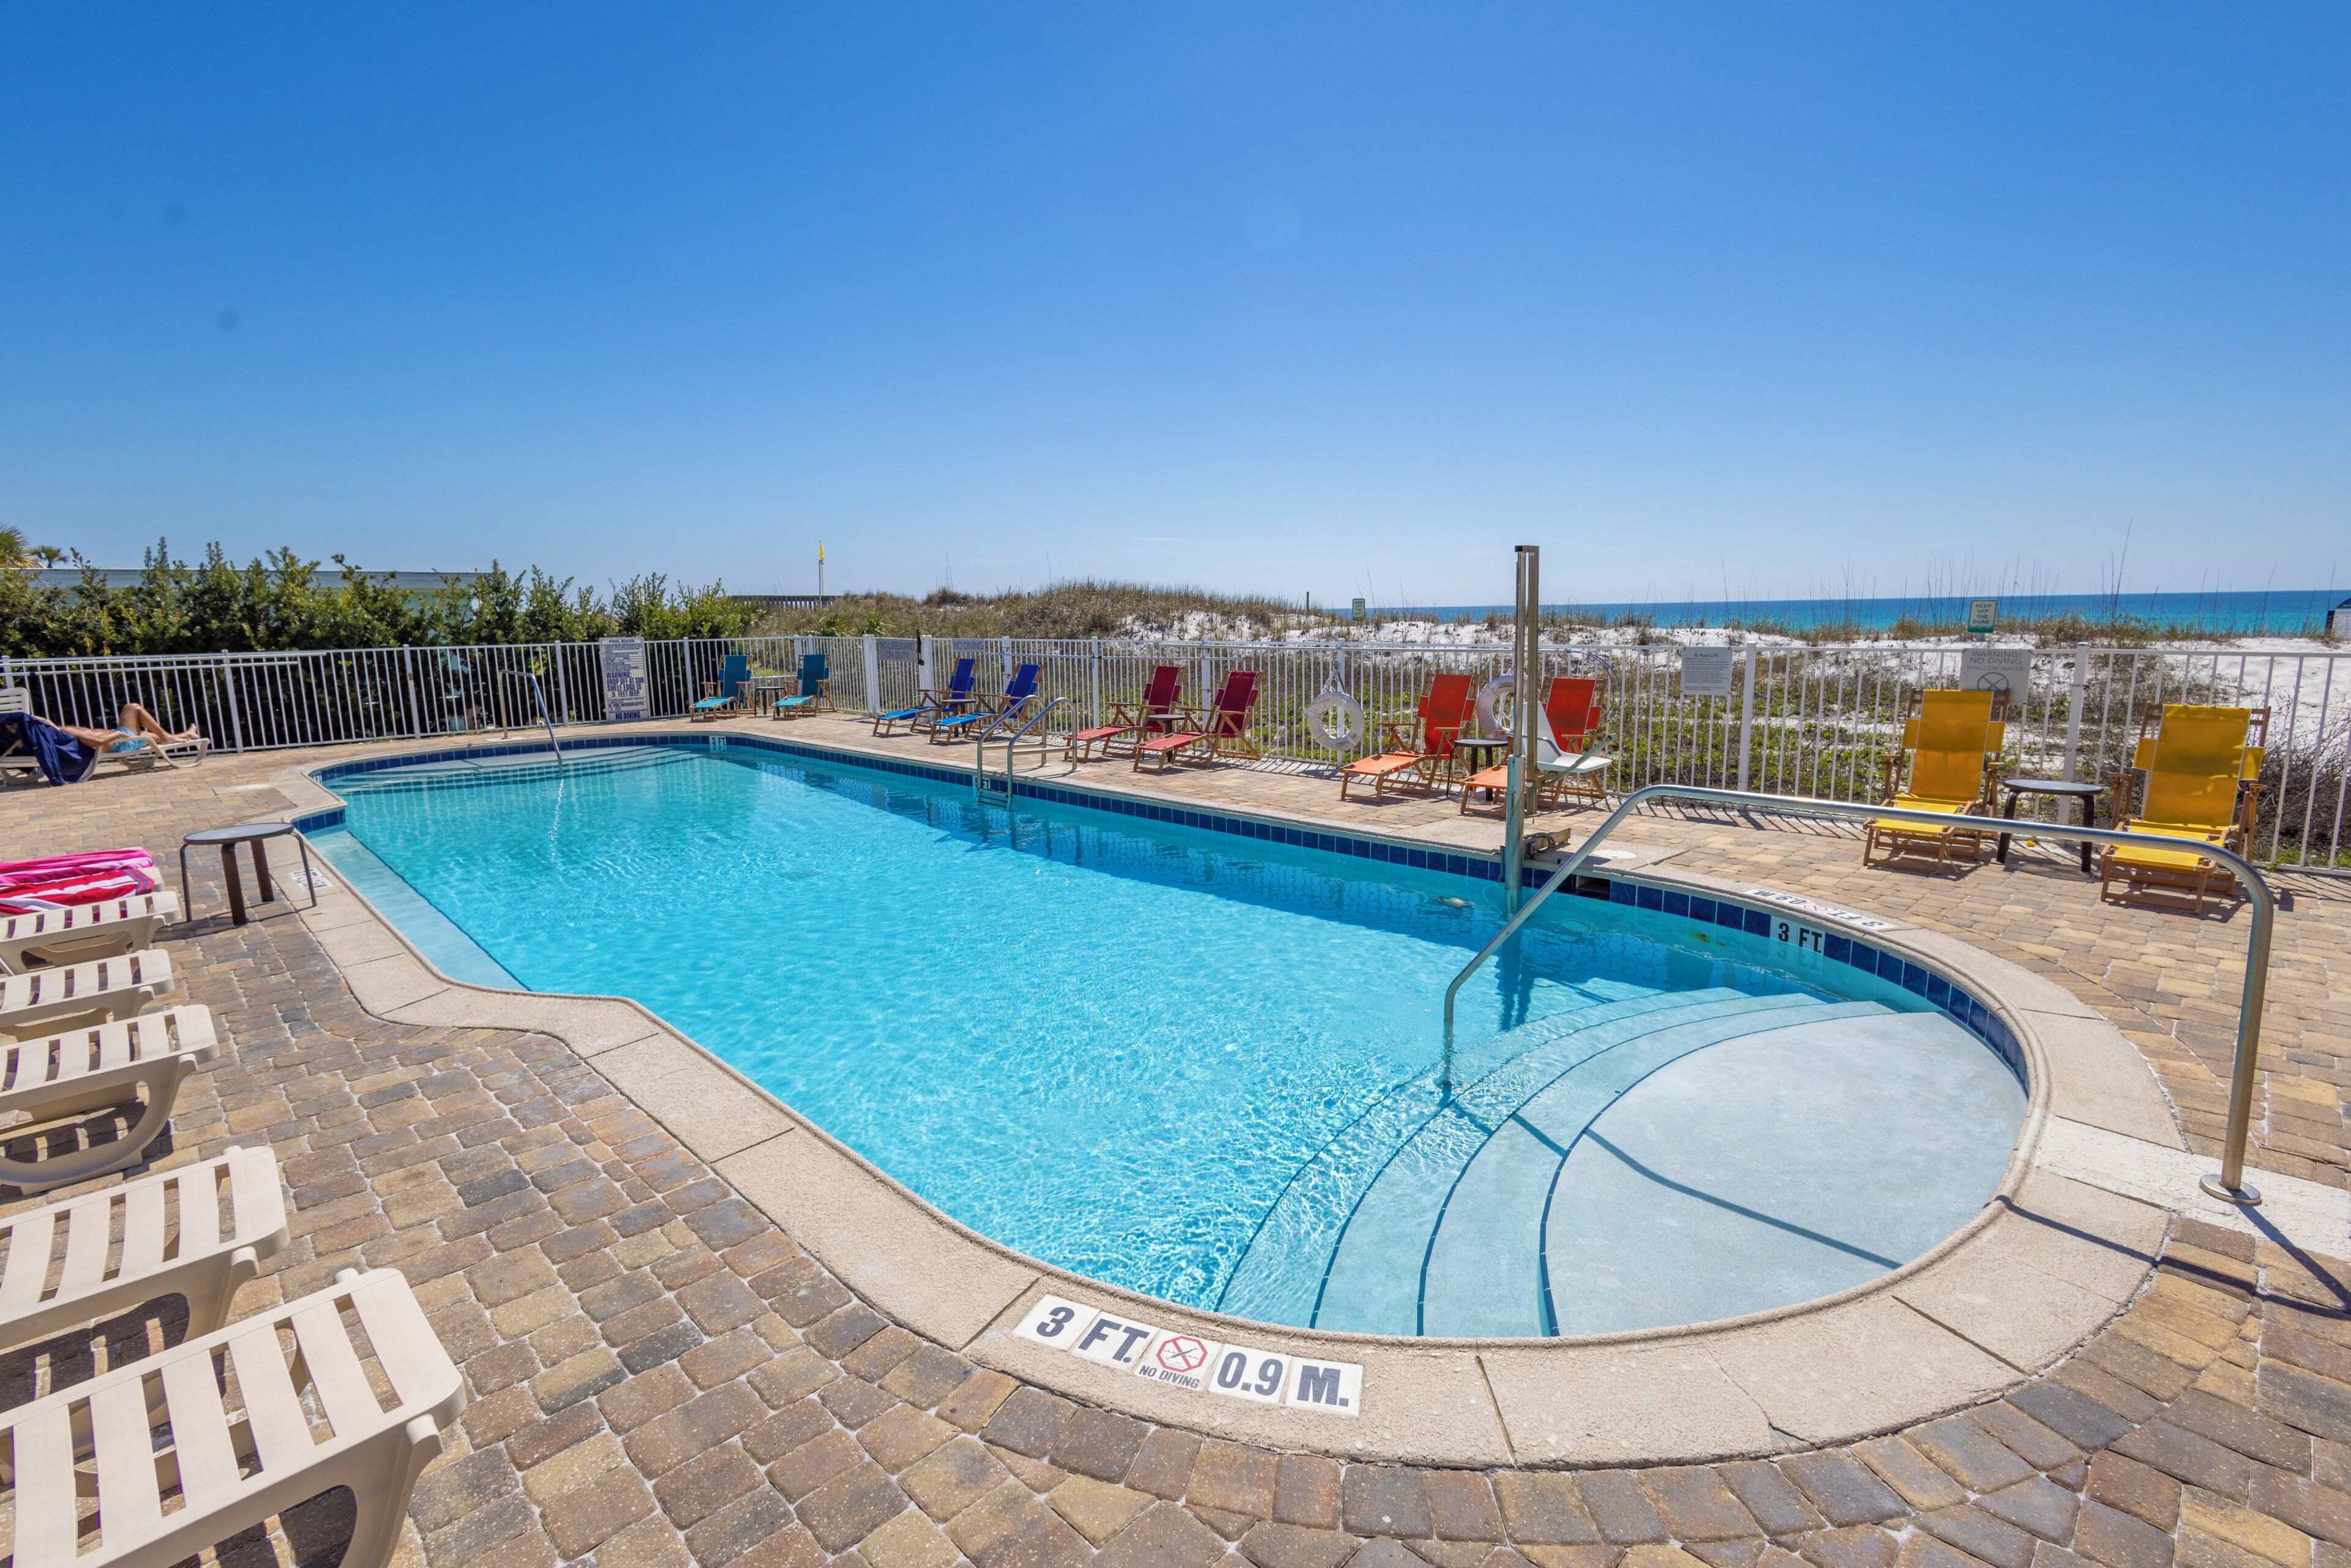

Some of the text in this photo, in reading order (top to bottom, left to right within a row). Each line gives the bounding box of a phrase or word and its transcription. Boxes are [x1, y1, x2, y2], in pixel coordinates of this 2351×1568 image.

[888, 642, 915, 651] LIFEGUARD
[954, 641, 983, 650] NO DIVING
[895, 651, 909, 659] DUTY
[1775, 896, 1807, 905] 0.9
[1778, 922, 1823, 954] 3 FT.
[1036, 1307, 1150, 1364] 3 FT.
[1138, 1365, 1201, 1389] NO DIVING
[1217, 1351, 1349, 1408] 0.9 M.
